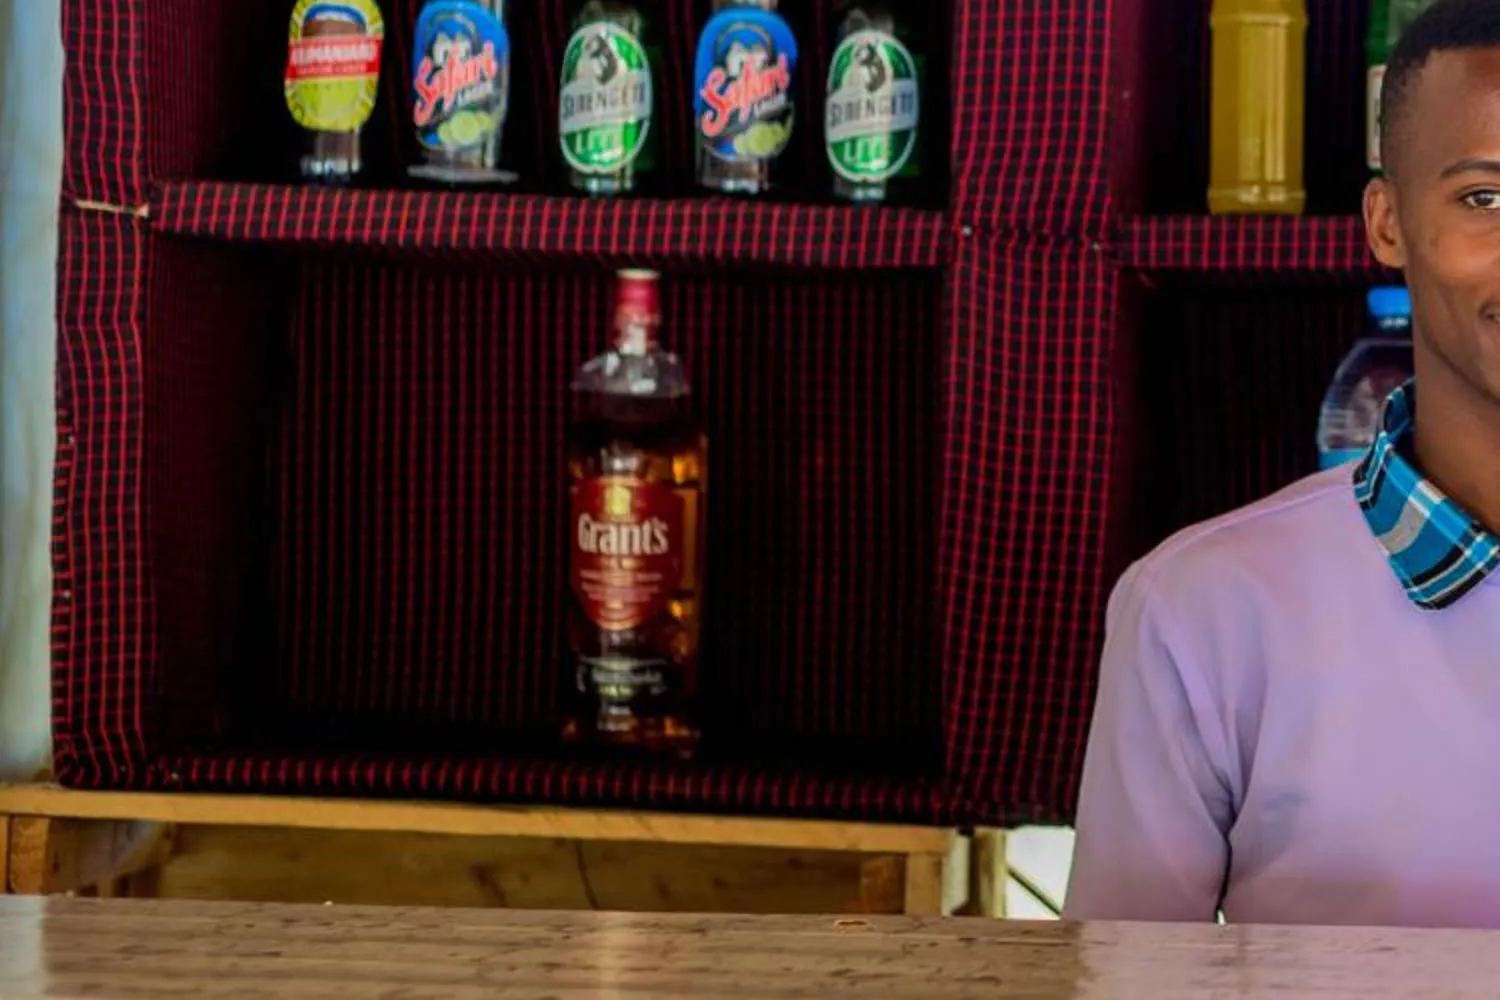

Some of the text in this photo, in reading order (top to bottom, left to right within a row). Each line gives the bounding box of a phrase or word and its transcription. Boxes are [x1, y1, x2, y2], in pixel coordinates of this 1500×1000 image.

[414, 40, 497, 127] Safari
[701, 53, 790, 136] Safari
[578, 513, 669, 556] Grant's
